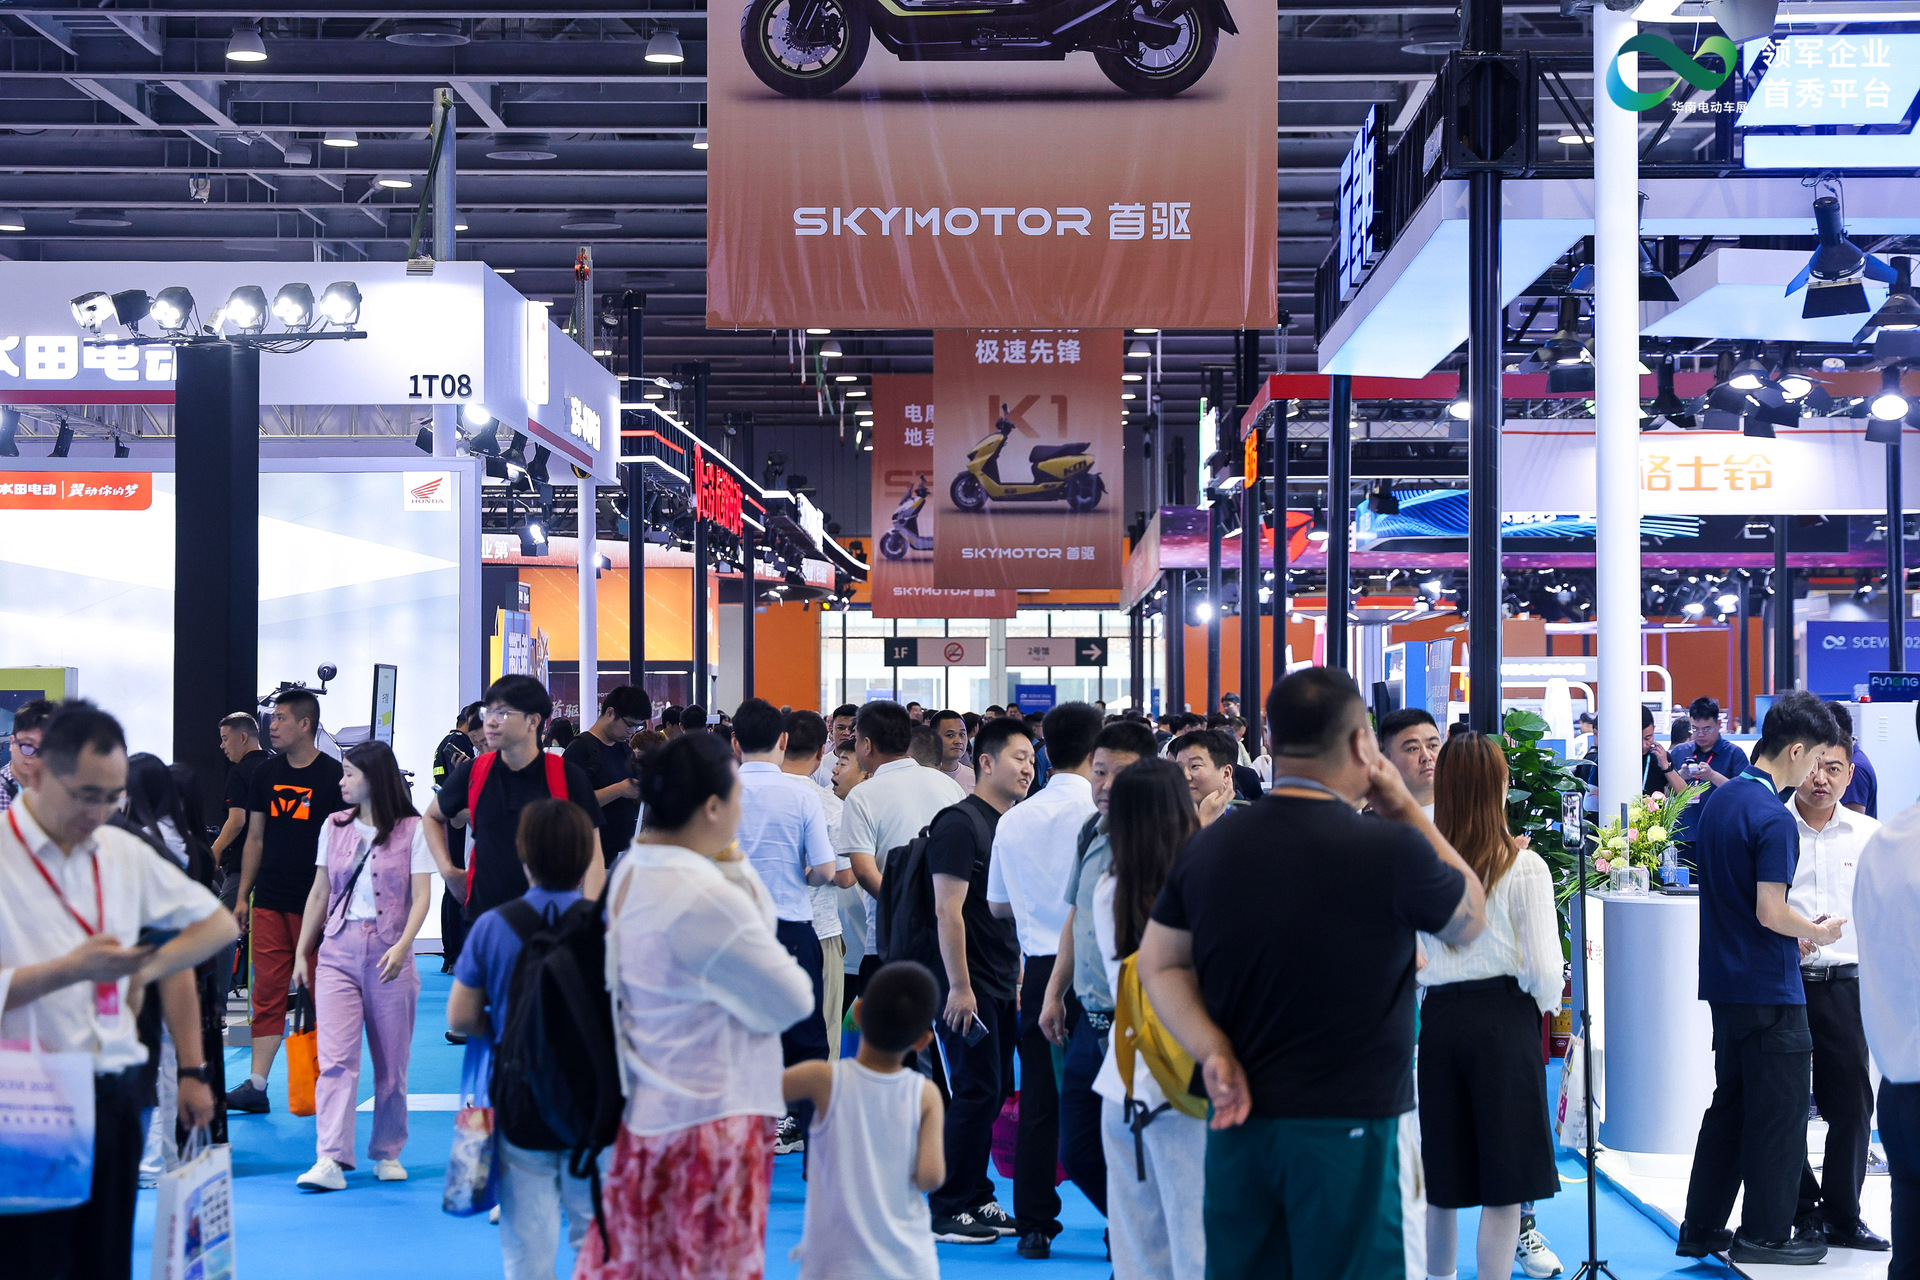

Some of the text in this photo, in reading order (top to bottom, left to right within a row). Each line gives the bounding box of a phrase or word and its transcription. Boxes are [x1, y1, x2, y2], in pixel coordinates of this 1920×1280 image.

[793, 202, 1191, 240] SKYMOTOR 首驱
[974, 338, 1081, 364] 极速先锋
[408, 374, 473, 398] 1T08
[988, 395, 1068, 439] K1
[961, 546, 1095, 560] SKYMOTOR 首驱
[893, 646, 909, 659] 1F
[1852, 636, 1889, 649] SCEV
